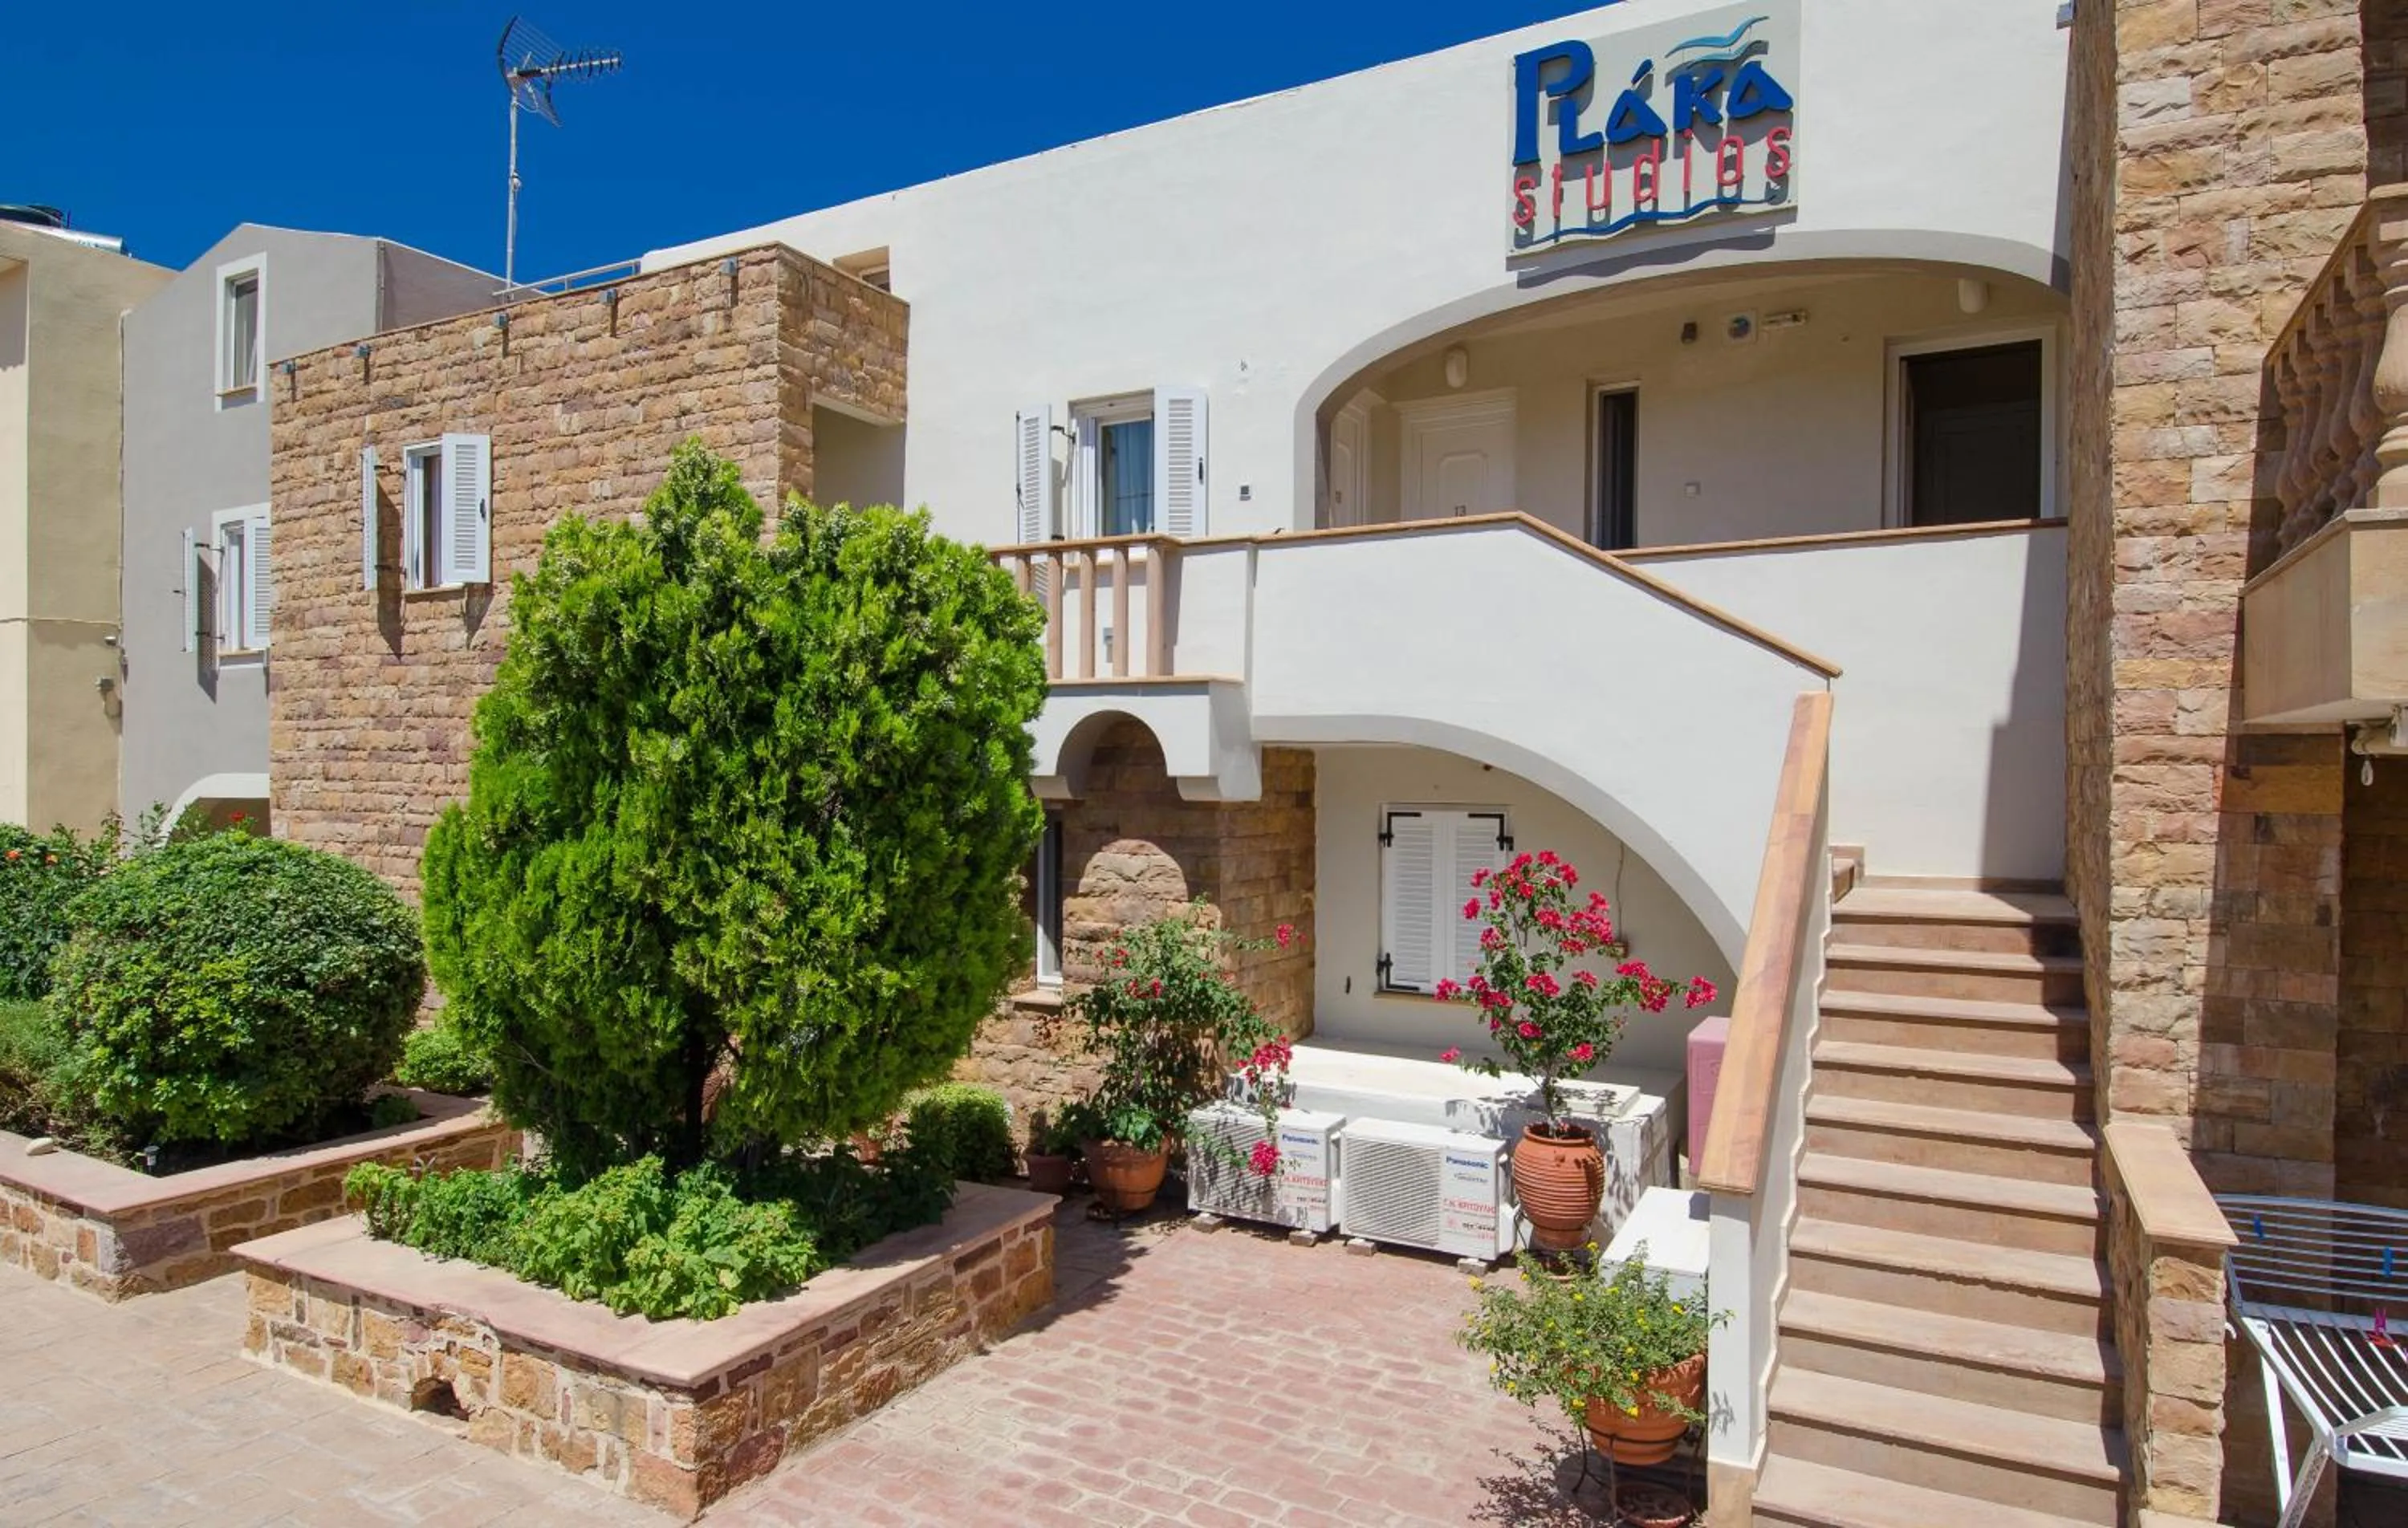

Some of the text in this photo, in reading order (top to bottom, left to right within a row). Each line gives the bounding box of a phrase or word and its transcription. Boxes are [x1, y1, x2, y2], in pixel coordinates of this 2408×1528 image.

[1512, 126, 1792, 226] studios
[1282, 1133, 1320, 1145] Panasonic
[1446, 1156, 1489, 1169] Panasonic
